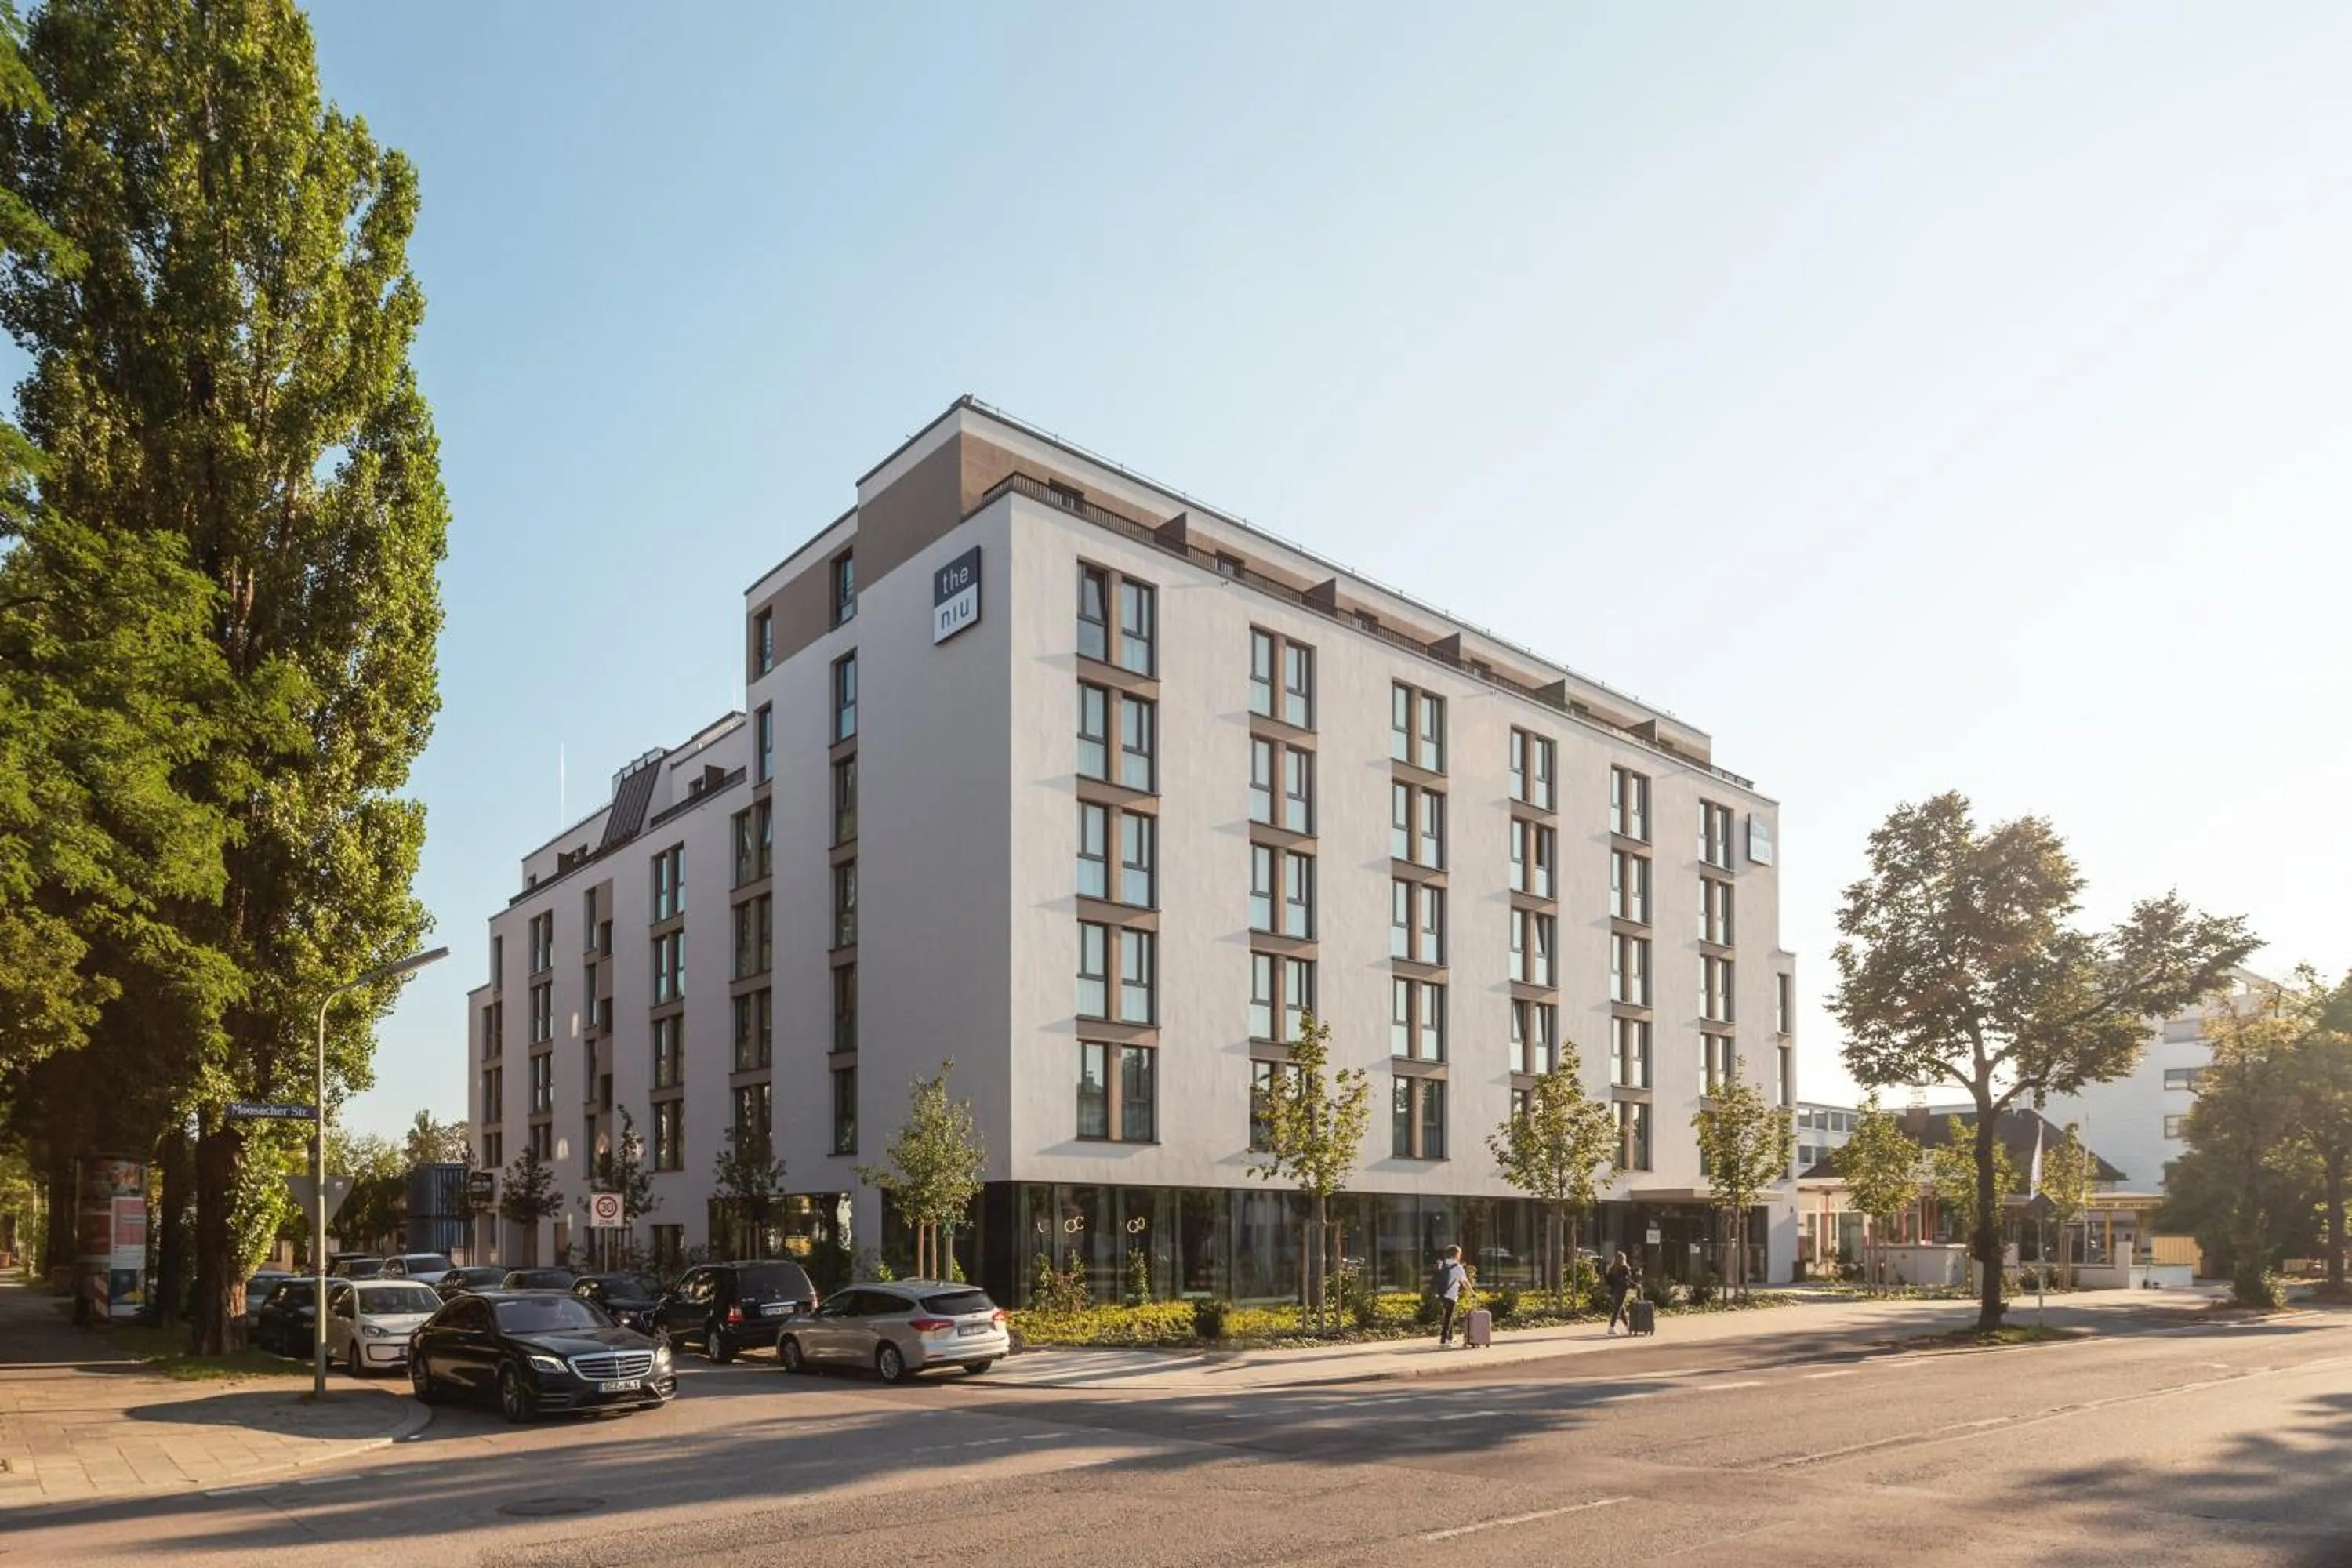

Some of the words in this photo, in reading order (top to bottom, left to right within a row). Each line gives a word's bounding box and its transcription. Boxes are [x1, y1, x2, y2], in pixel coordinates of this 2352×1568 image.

[943, 566, 969, 594] the
[942, 598, 969, 630] niu
[231, 1104, 288, 1116] Moosacher
[291, 1106, 310, 1116] Str.
[601, 1201, 614, 1213] 30
